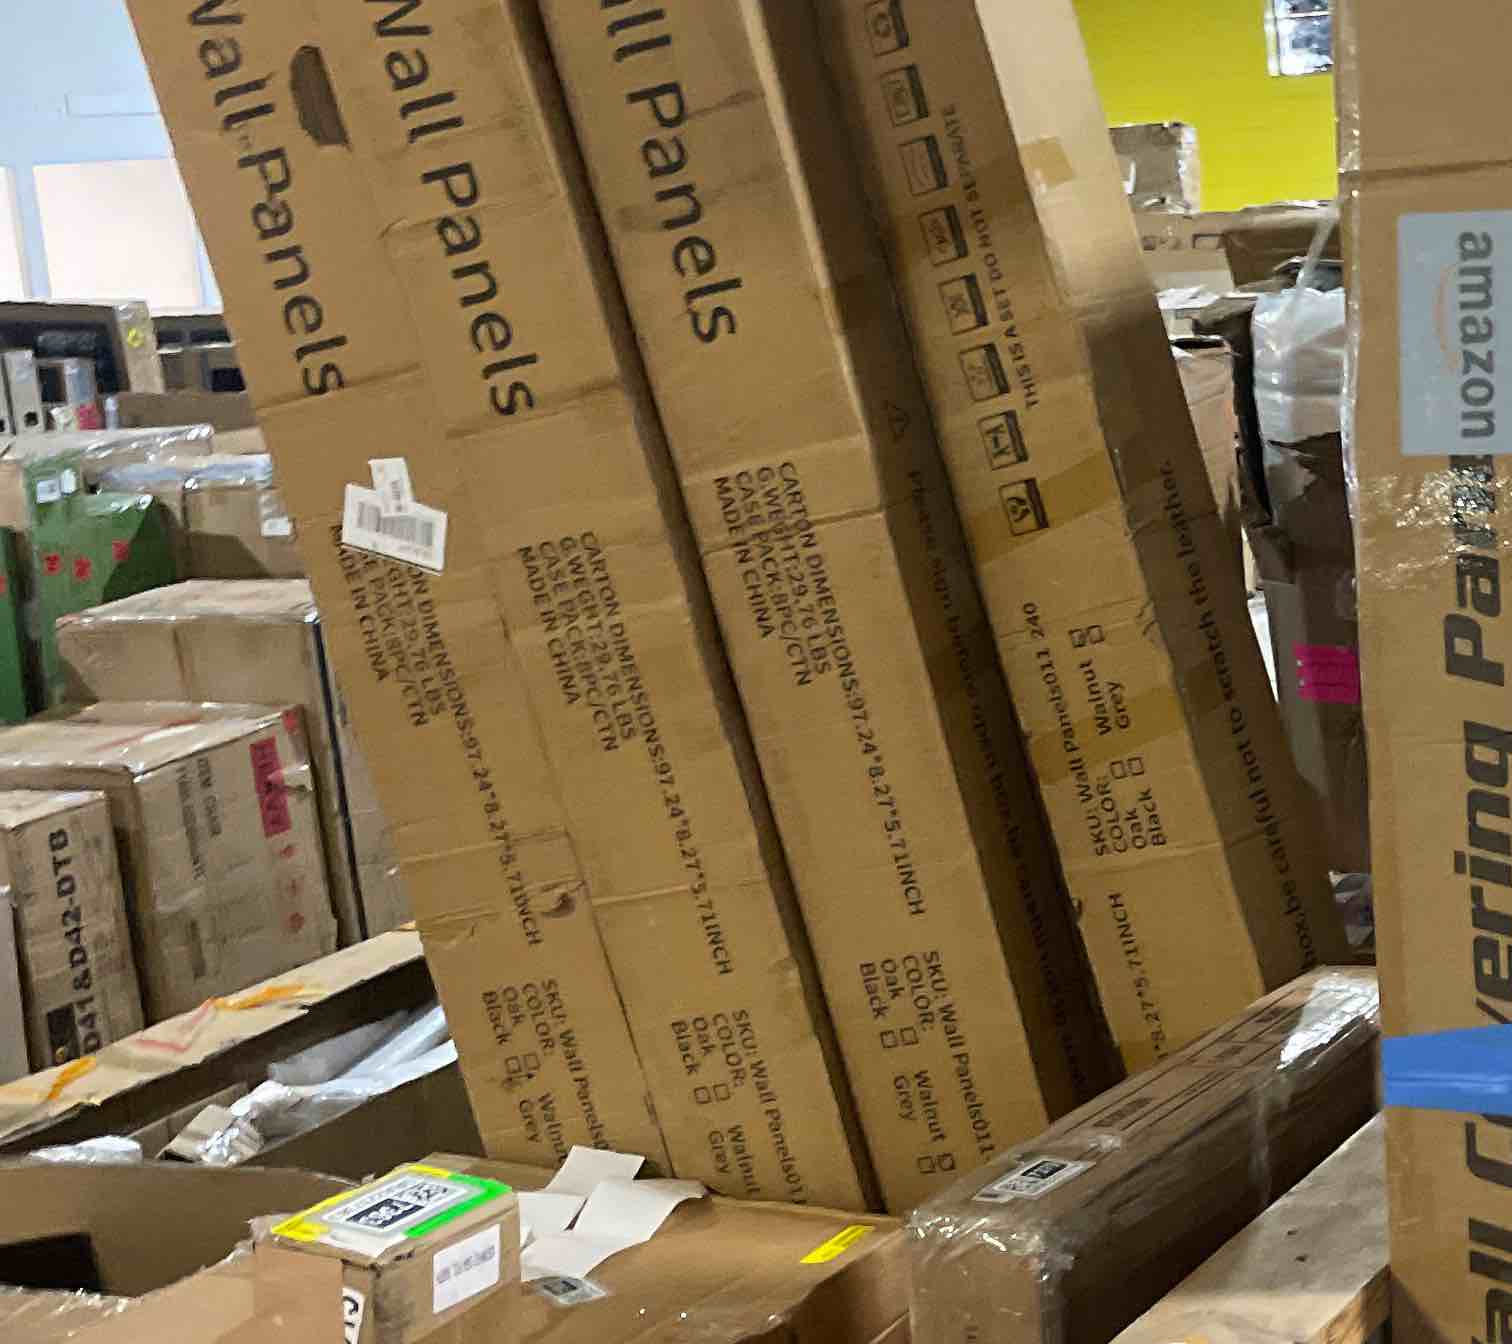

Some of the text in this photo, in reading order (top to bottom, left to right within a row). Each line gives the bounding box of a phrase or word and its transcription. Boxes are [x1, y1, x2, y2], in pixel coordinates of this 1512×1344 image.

[235, 145, 359, 397] Panels
[419, 158, 551, 419] Panels
[624, 77, 755, 346] Panels
[1458, 231, 1496, 440] amazon
[576, 528, 620, 618] CARTON
[710, 473, 778, 641] MADE IN CHINA
[775, 459, 818, 551] CARTON
[355, 613, 392, 684] CHINA
[515, 543, 584, 707] MADE IN CHINA
[1066, 757, 1095, 804] Wall
[1076, 657, 1148, 851] Oak Walnut
[1103, 678, 1168, 848] Black Grey
[479, 988, 514, 1046] Black
[556, 1028, 587, 1074] Wall
[668, 1018, 735, 1177] Black Grey
[689, 1014, 717, 1057] Oak
[747, 1059, 779, 1106] Wall
[857, 958, 920, 1124] Black Grey
[878, 955, 949, 1144] Oak Walnut
[937, 1001, 967, 1049] Wall
